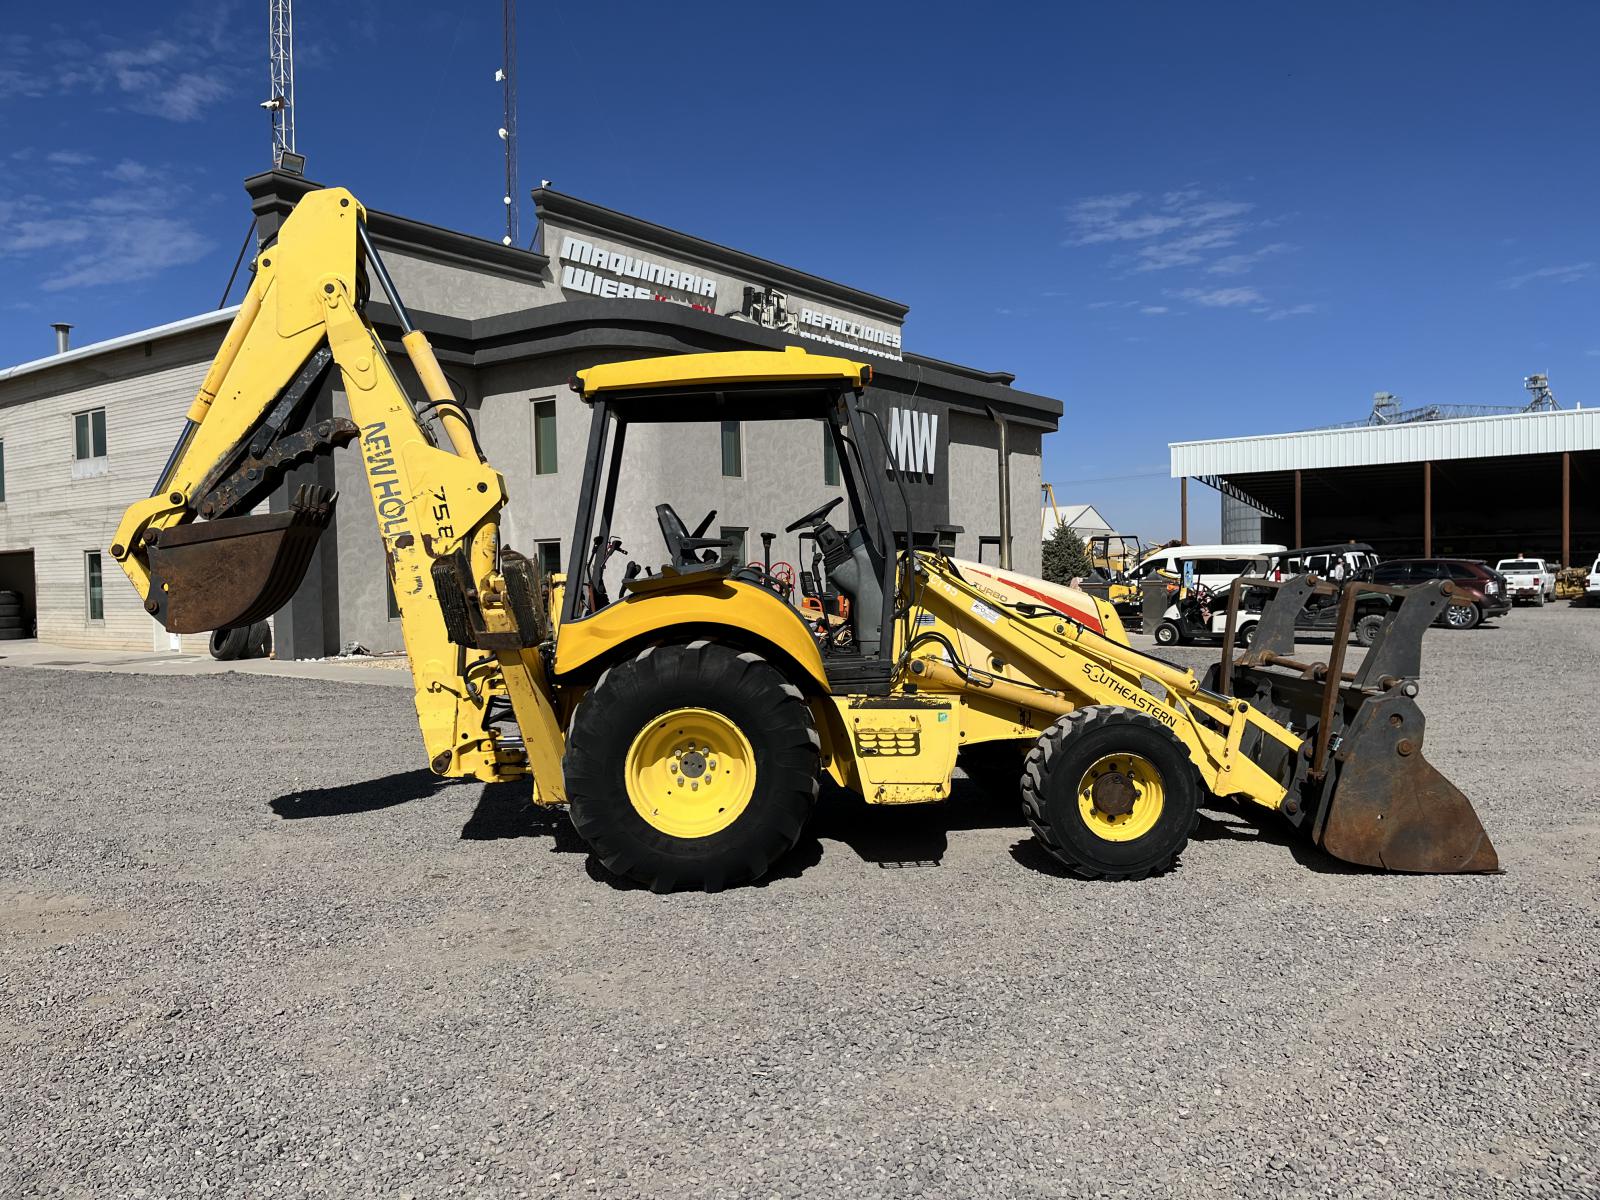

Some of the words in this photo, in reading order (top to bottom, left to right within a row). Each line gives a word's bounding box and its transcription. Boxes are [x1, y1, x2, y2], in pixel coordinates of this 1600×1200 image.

[561, 236, 717, 298] MAQUINARIA
[801, 308, 901, 348] REFACCIONES
[365, 421, 397, 476] NEW
[886, 407, 938, 474] MW
[974, 582, 1008, 602] TURBO
[1082, 663, 1177, 727] SOUTHEASTERN
